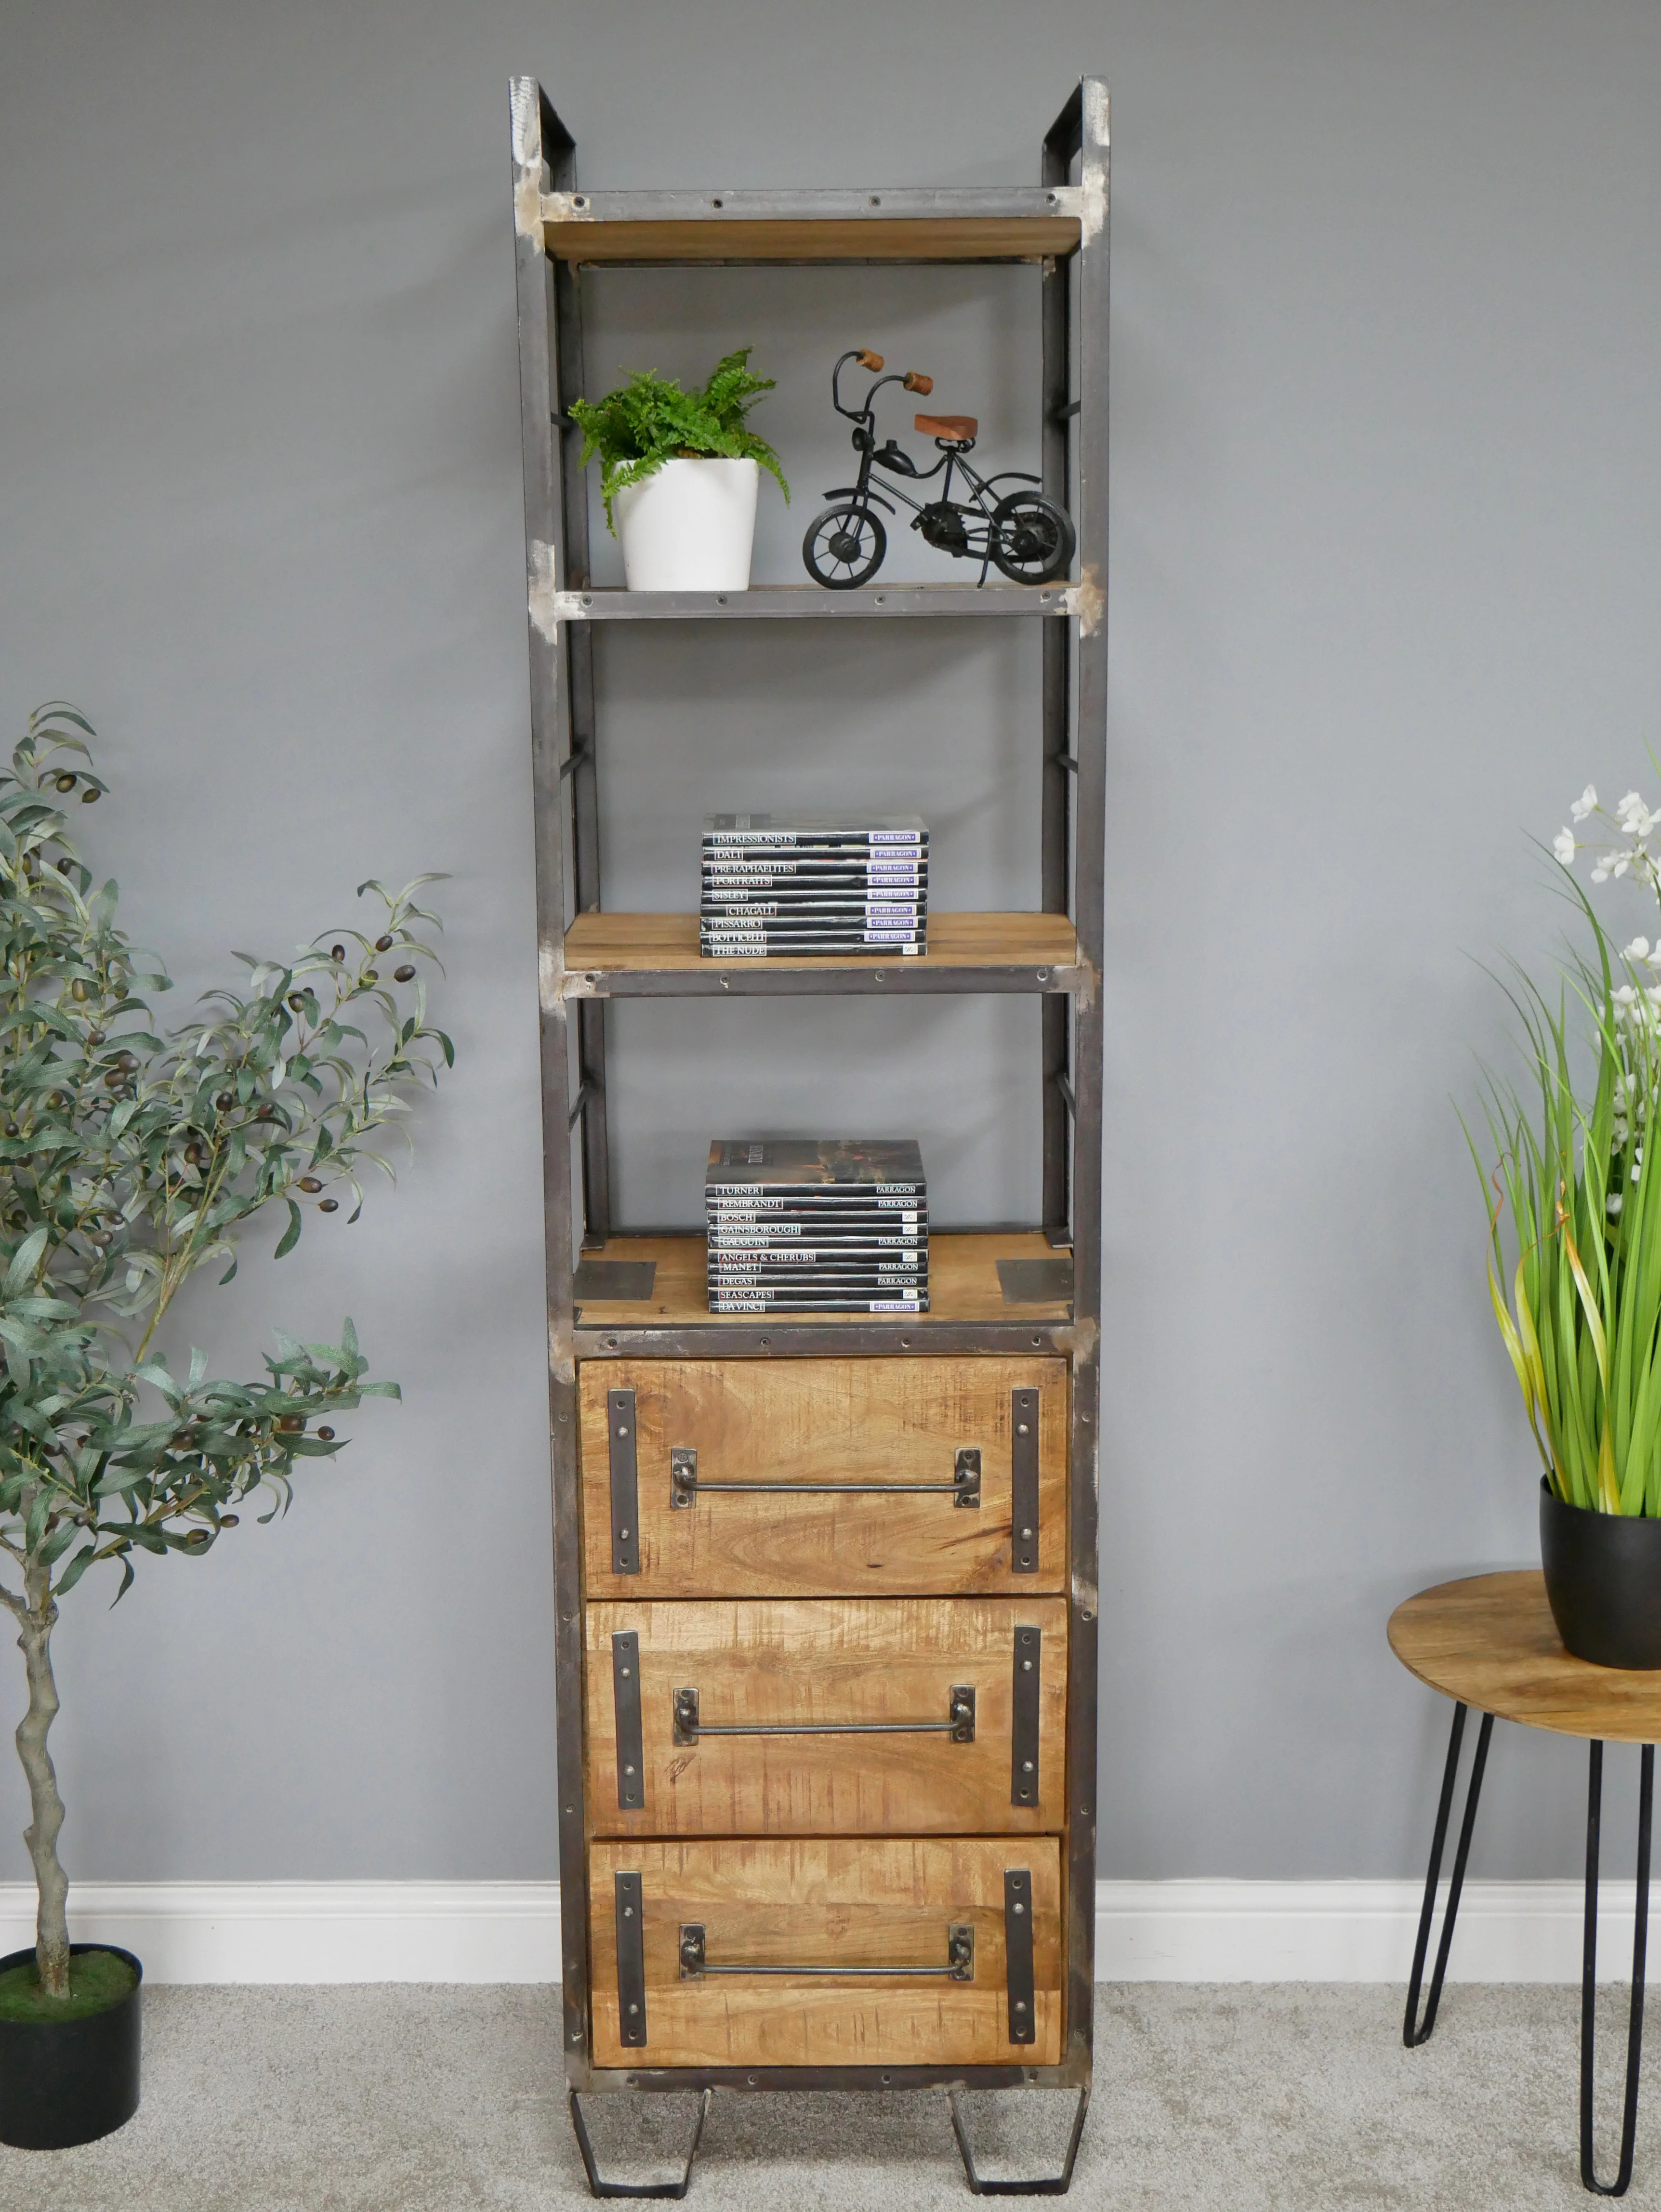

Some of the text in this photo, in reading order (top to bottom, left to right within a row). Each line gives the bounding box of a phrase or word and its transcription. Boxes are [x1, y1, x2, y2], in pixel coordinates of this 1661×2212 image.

[717, 834, 794, 843] IMPRESSIONISTS
[717, 851, 740, 859] DALI
[714, 891, 745, 899] SISLEY
[729, 907, 774, 915] CHAGALL
[715, 920, 761, 928] PISSARRO
[716, 947, 765, 955] THE NUDE
